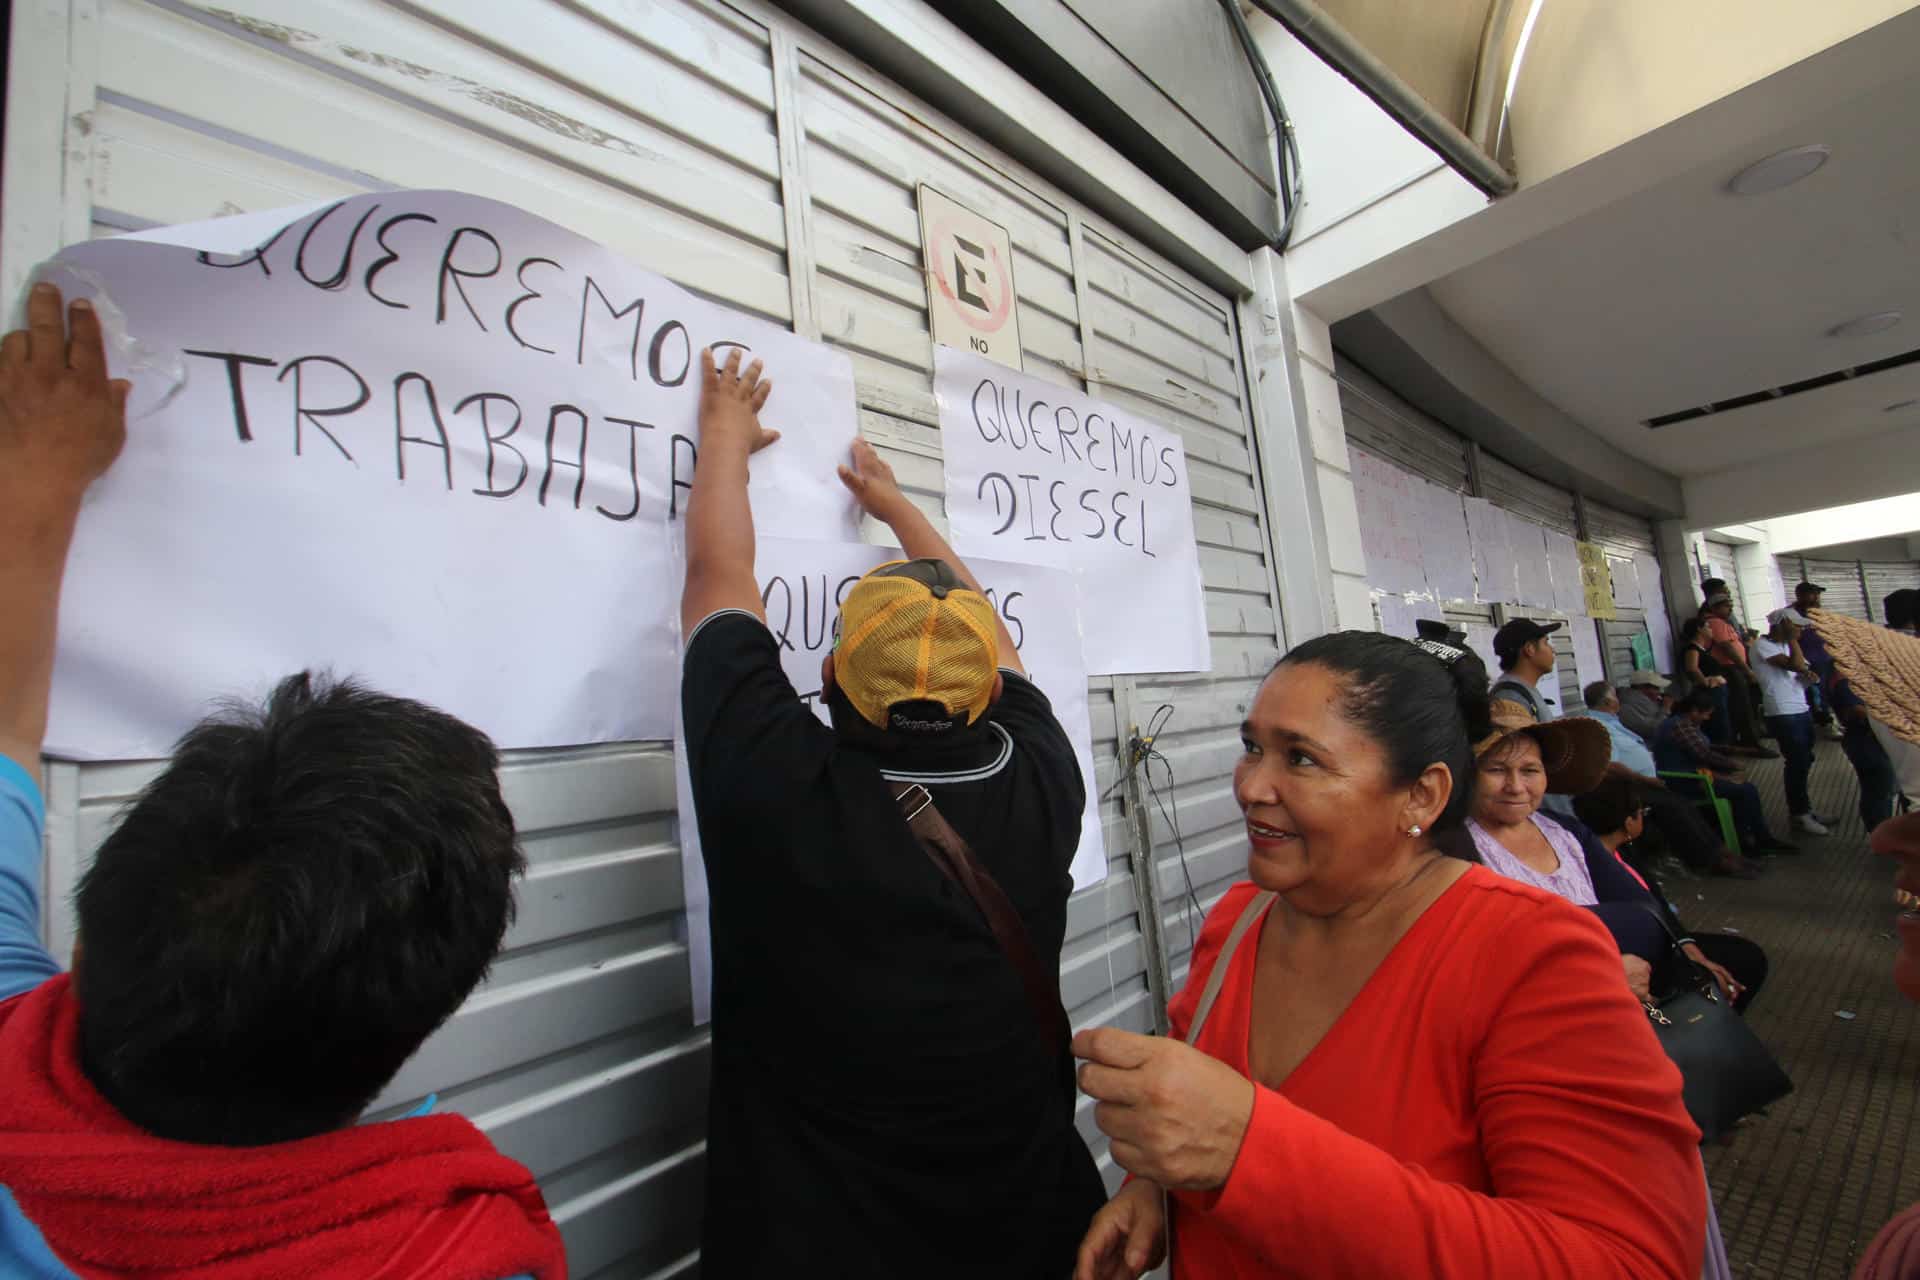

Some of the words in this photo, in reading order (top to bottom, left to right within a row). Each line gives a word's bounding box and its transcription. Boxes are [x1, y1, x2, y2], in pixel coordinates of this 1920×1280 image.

[970, 335, 989, 354] NO
[184, 349, 750, 521] TRABAJA
[971, 378, 1178, 487] QUEREMOS
[977, 471, 1156, 558] DIESEL
